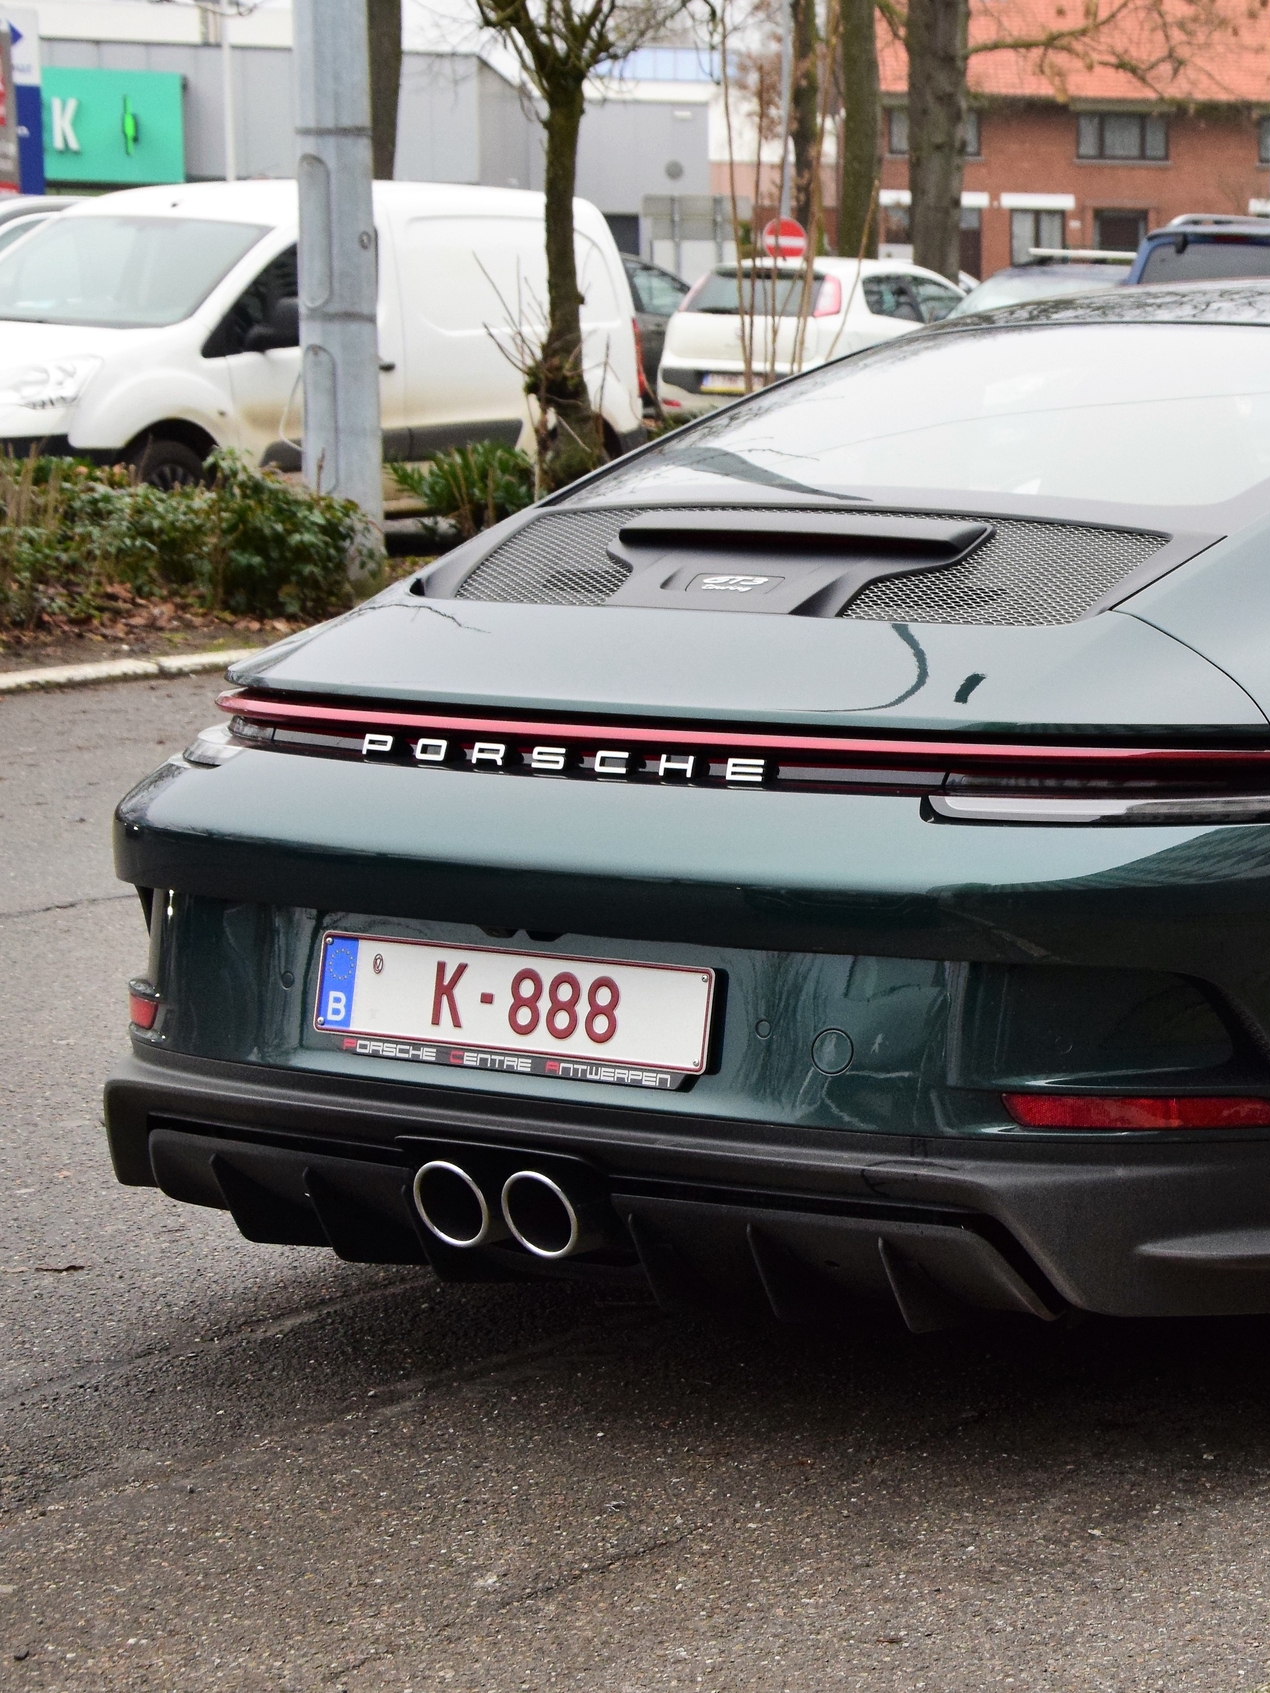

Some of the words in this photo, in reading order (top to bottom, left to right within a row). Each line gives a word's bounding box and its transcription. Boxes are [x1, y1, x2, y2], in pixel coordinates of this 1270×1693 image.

[51, 96, 80, 151] K
[361, 732, 768, 783] PORSCHE
[326, 991, 346, 1021] B
[430, 959, 621, 1044] K-888
[342, 1037, 437, 1061] PORSCHE
[449, 1050, 532, 1072] CENTRE
[544, 1060, 671, 1087] ANTWERPEN
